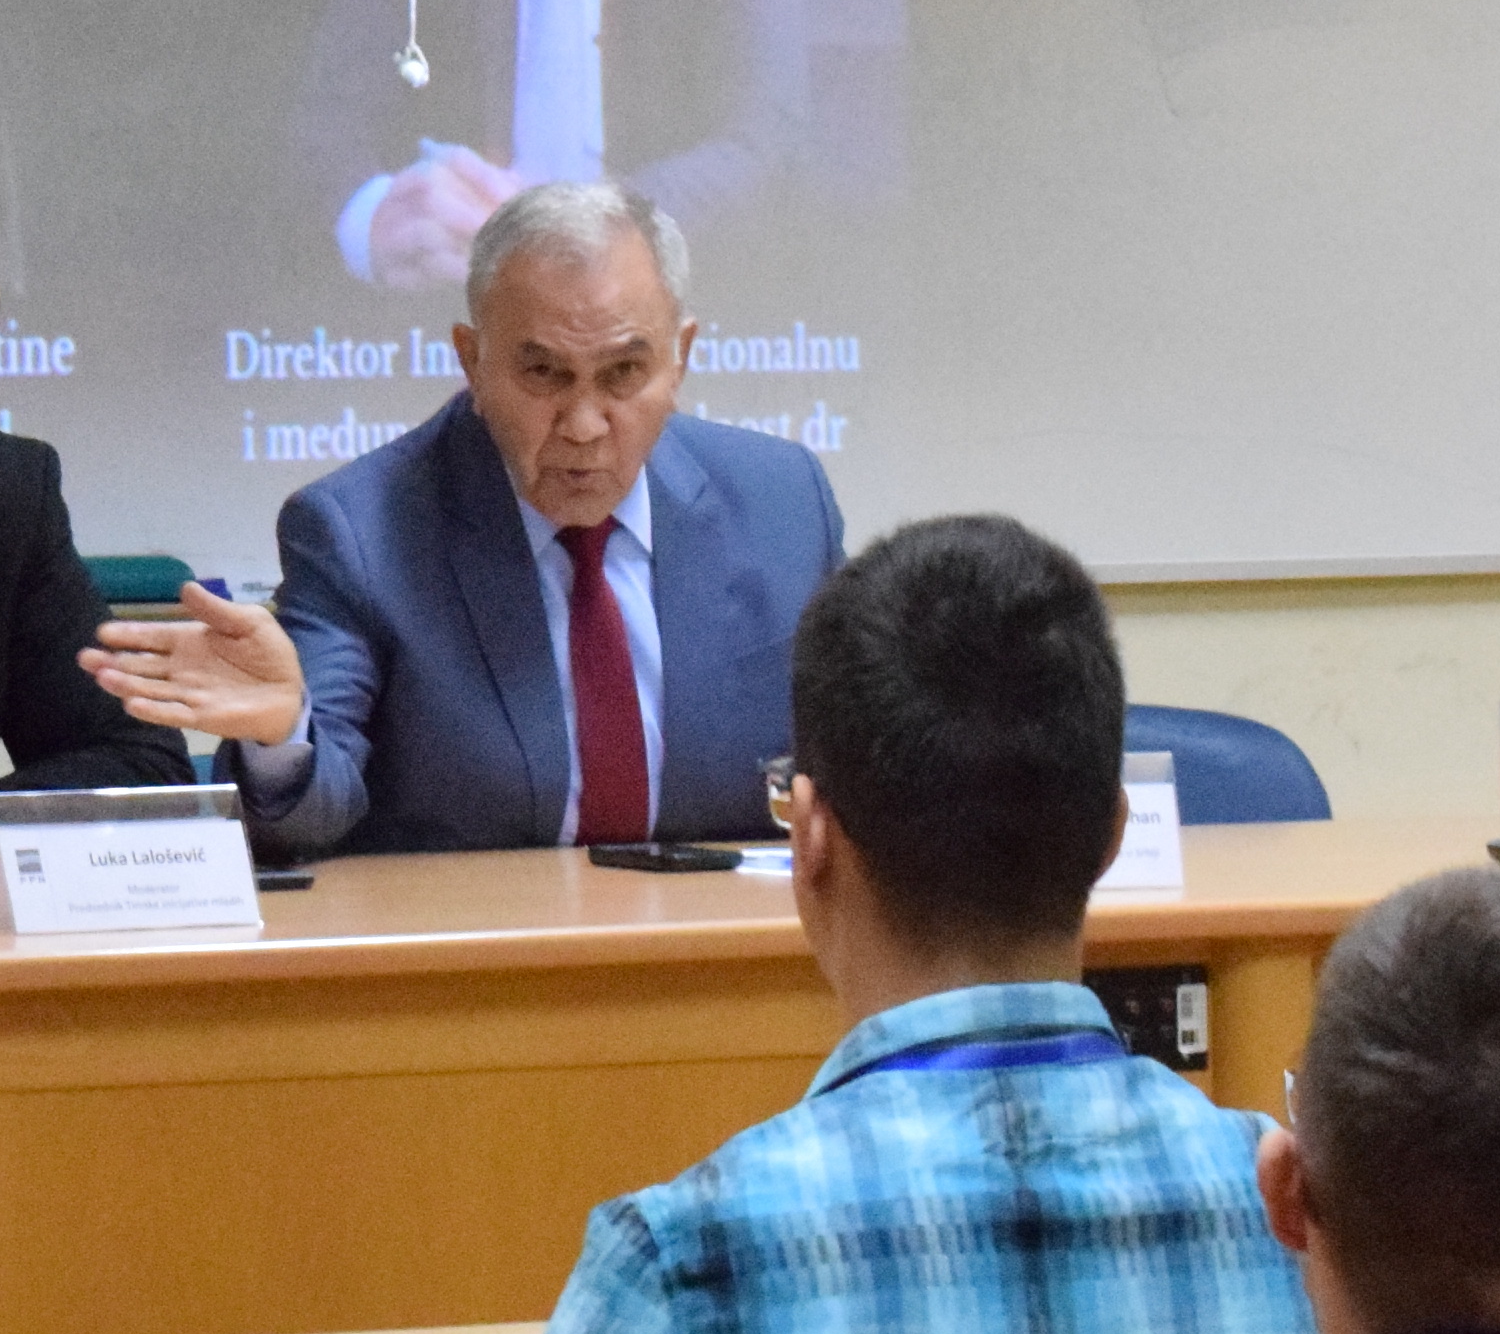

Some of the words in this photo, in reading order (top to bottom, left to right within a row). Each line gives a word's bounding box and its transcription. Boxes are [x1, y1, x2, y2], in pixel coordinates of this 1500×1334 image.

[226, 327, 399, 380] Direktor
[688, 322, 860, 373] cionalnu
[242, 410, 256, 461] i
[801, 401, 847, 451] dr
[88, 850, 128, 867] Luka
[132, 846, 207, 866] Lalošević
